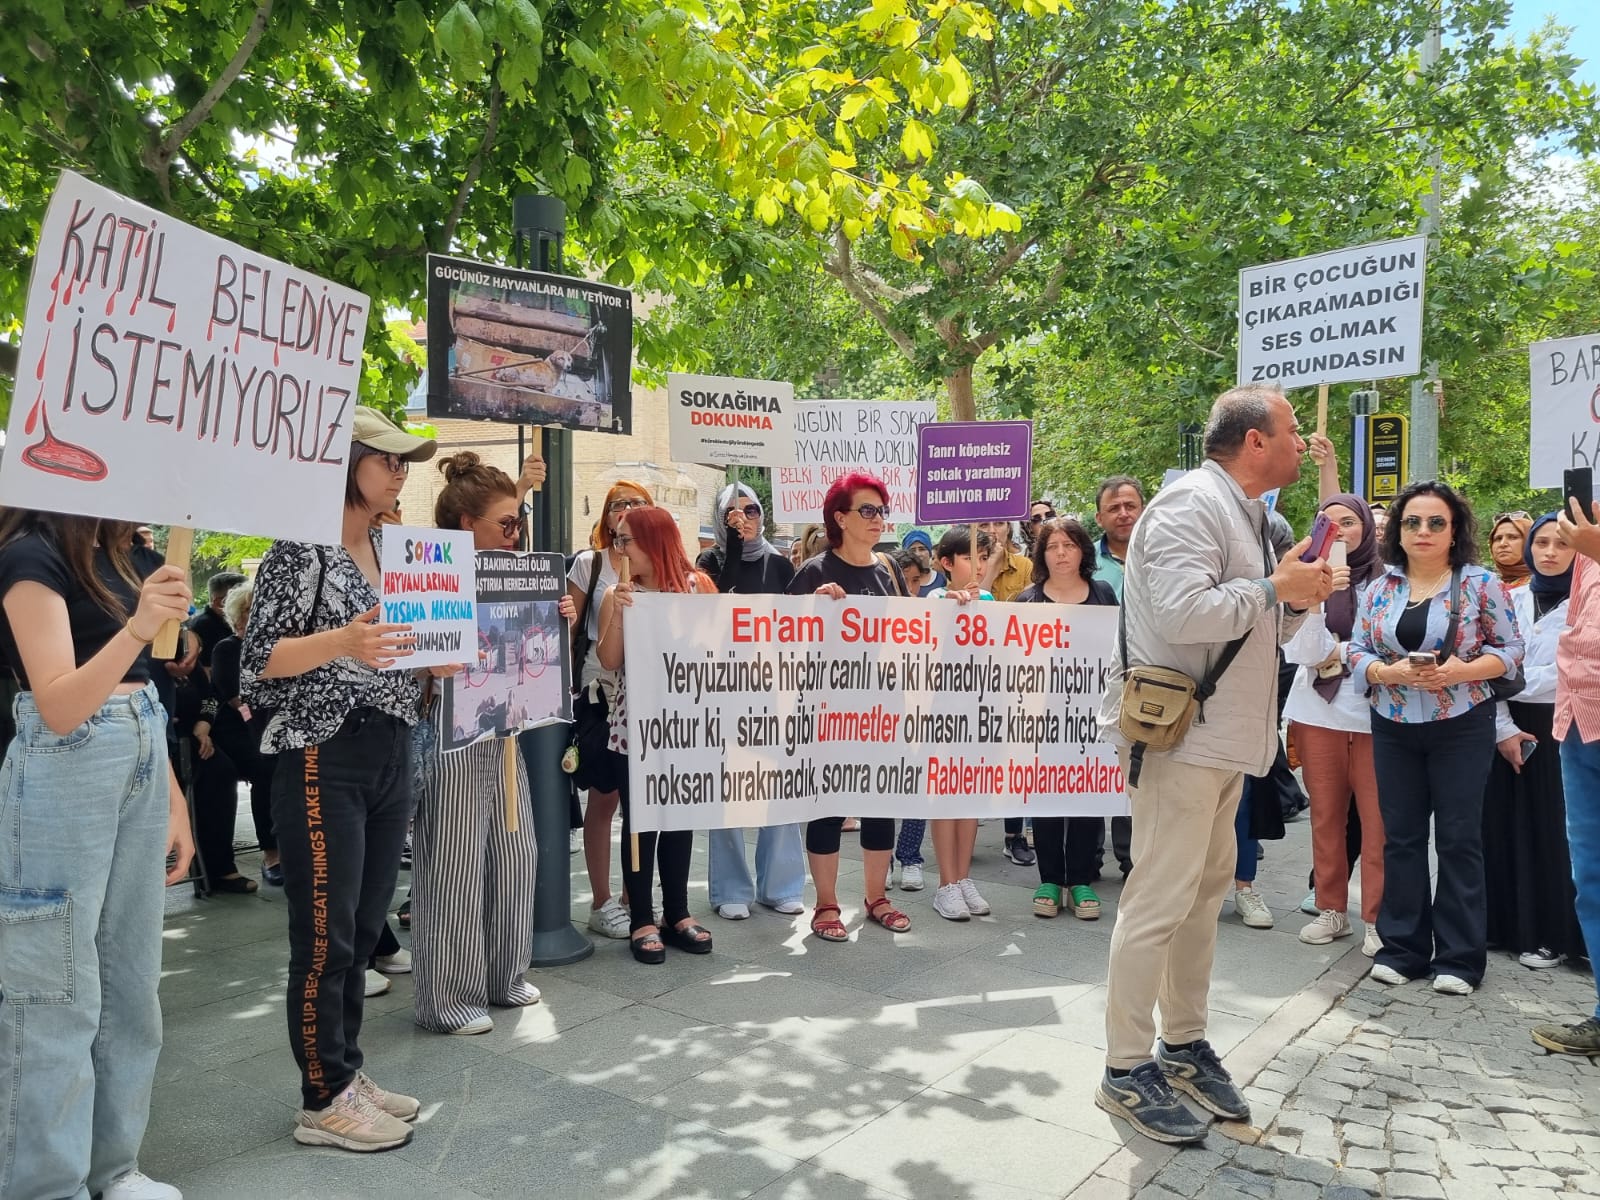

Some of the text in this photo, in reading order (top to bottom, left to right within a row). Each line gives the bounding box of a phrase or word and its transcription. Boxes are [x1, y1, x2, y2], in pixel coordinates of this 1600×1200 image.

[62, 199, 362, 366] KATİL BELEDİYE
[435, 265, 490, 286] GÜCÜNÜZ
[492, 277, 564, 297] HAYVANLARA
[567, 287, 578, 299] MI
[582, 291, 622, 308] YETİYOR
[1249, 252, 1416, 298] BİR ÇOCUĞUN
[1245, 281, 1419, 330] ÇIKARAMADIĞI
[1261, 316, 1397, 351] SES OLMAK
[1252, 346, 1405, 381] ZORUNDASIN
[62, 306, 350, 465] İSTEMİYORUZ
[680, 390, 782, 413] SOKAĞIMA
[691, 411, 773, 430] DOKUNMA
[793, 404, 842, 433] UGÜN
[928, 442, 1011, 459] Tanrı köpeksiz
[927, 467, 962, 482] sokak
[927, 487, 1012, 505] BİLMİYOR MU?
[405, 539, 452, 565] SOKAK
[384, 571, 459, 595] HAYVANLARININ
[432, 600, 473, 621] HAKKINA
[489, 605, 519, 619] KONYA
[732, 607, 1071, 656] En'am Suresi, 38. Ayet:
[663, 651, 773, 704] Yeryüzünde
[778, 652, 826, 703] hiçbir
[830, 652, 871, 691] canlı
[877, 660, 896, 691] ve
[901, 653, 920, 691] iki
[925, 654, 1001, 702] kanadıyla
[1006, 664, 1045, 703] uçan
[1050, 657, 1093, 704] hiçbir
[639, 702, 1105, 762] yoktur ki, sizin gibi ümmetler olmasın. Biz kitapta hiçb
[304, 744, 319, 782] TIME
[646, 764, 714, 806] noksan
[720, 757, 819, 803] bırakmadık,
[822, 762, 870, 795] sonra
[876, 757, 922, 795] onlar
[926, 757, 1004, 795] Rablerine
[305, 786, 322, 827] TAKE
[310, 830, 328, 887] THINGS
[313, 889, 328, 936] GREAT
[303, 1002, 317, 1022] UP
[303, 1024, 317, 1058] GIVE
